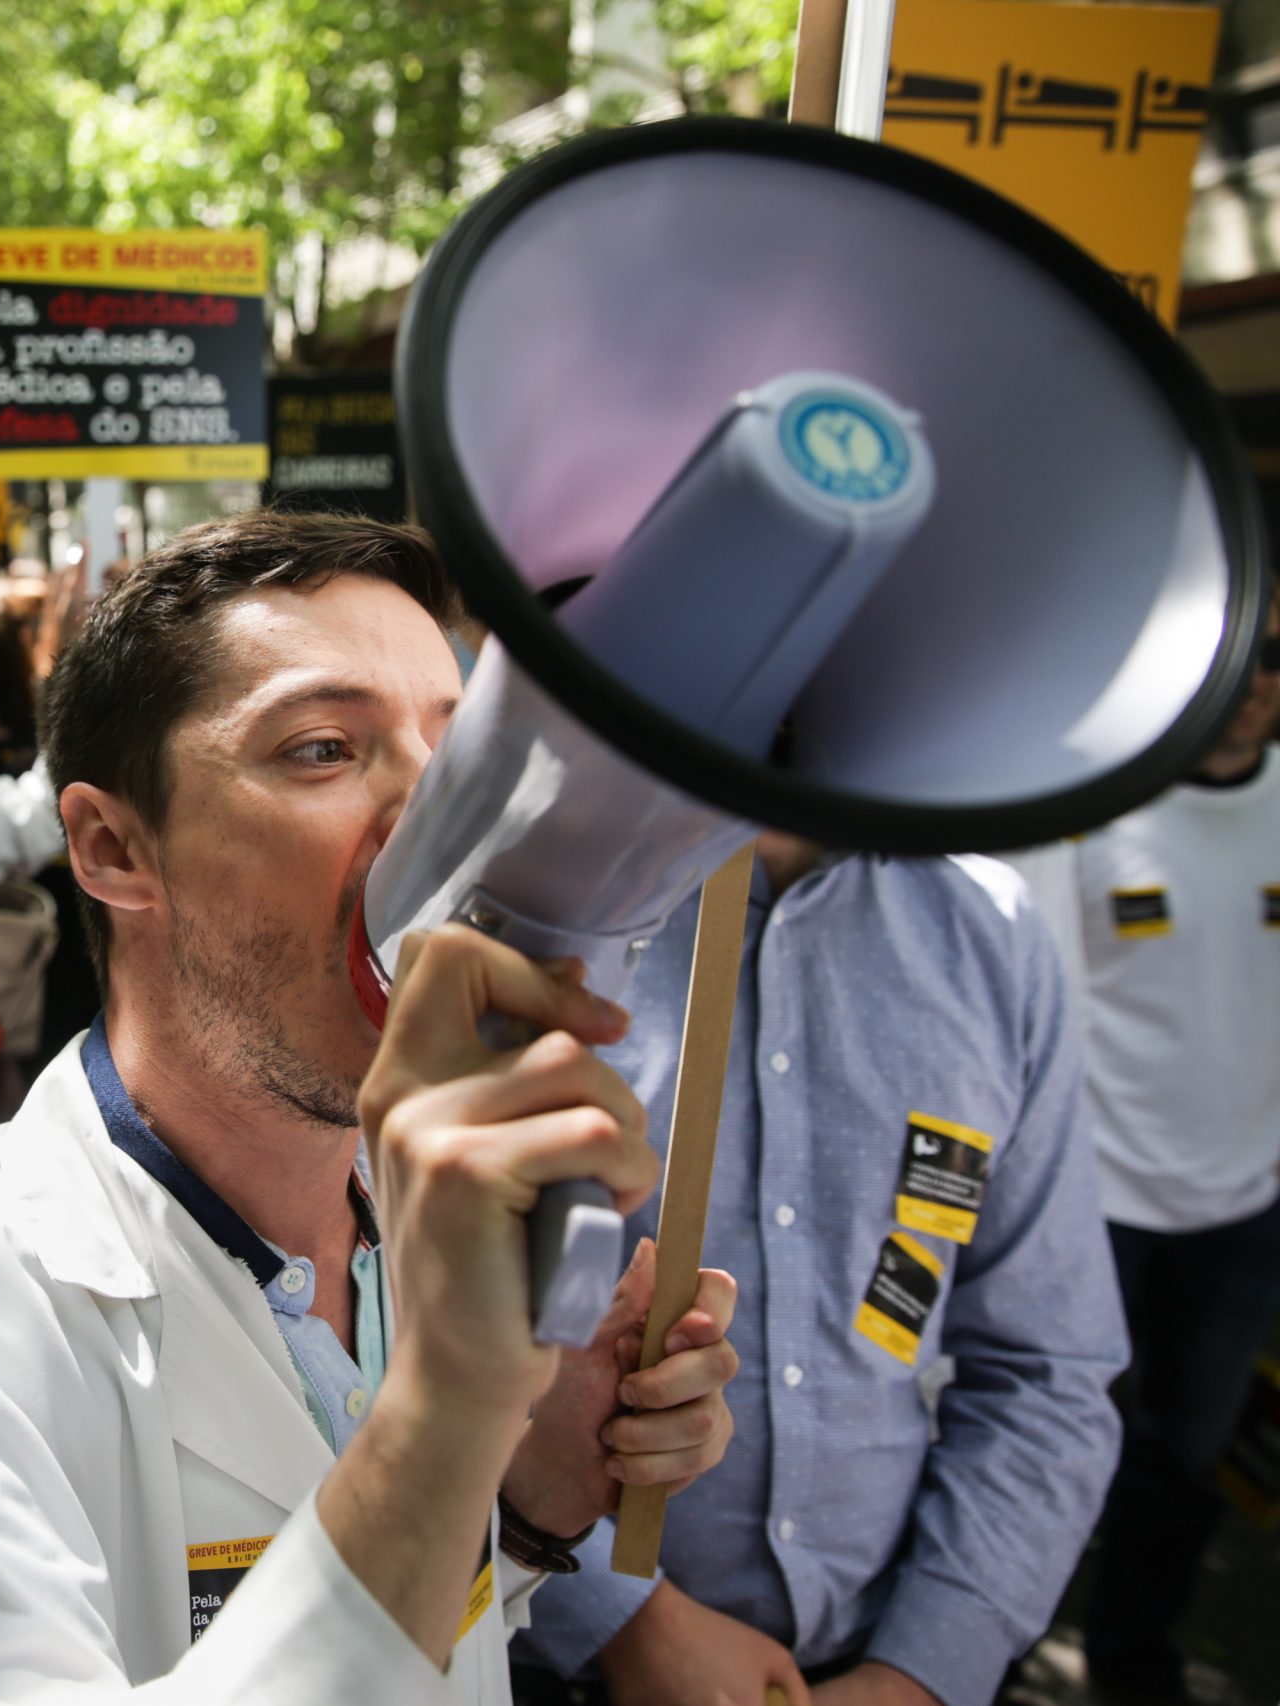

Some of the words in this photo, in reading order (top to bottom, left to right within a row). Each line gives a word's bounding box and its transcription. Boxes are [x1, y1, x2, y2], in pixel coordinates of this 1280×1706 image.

[61, 242, 100, 271] DE
[114, 239, 258, 271] MÉDICOS
[48, 290, 238, 328] dignidade
[15, 327, 195, 371] profissão
[103, 373, 130, 404] e
[139, 368, 226, 410] pela
[89, 406, 140, 443] do
[149, 406, 239, 443] SNS.
[189, 1546, 217, 1559] GREVE
[220, 1544, 231, 1555] DE
[191, 1594, 222, 1609] Pela
[193, 1613, 209, 1626] da
